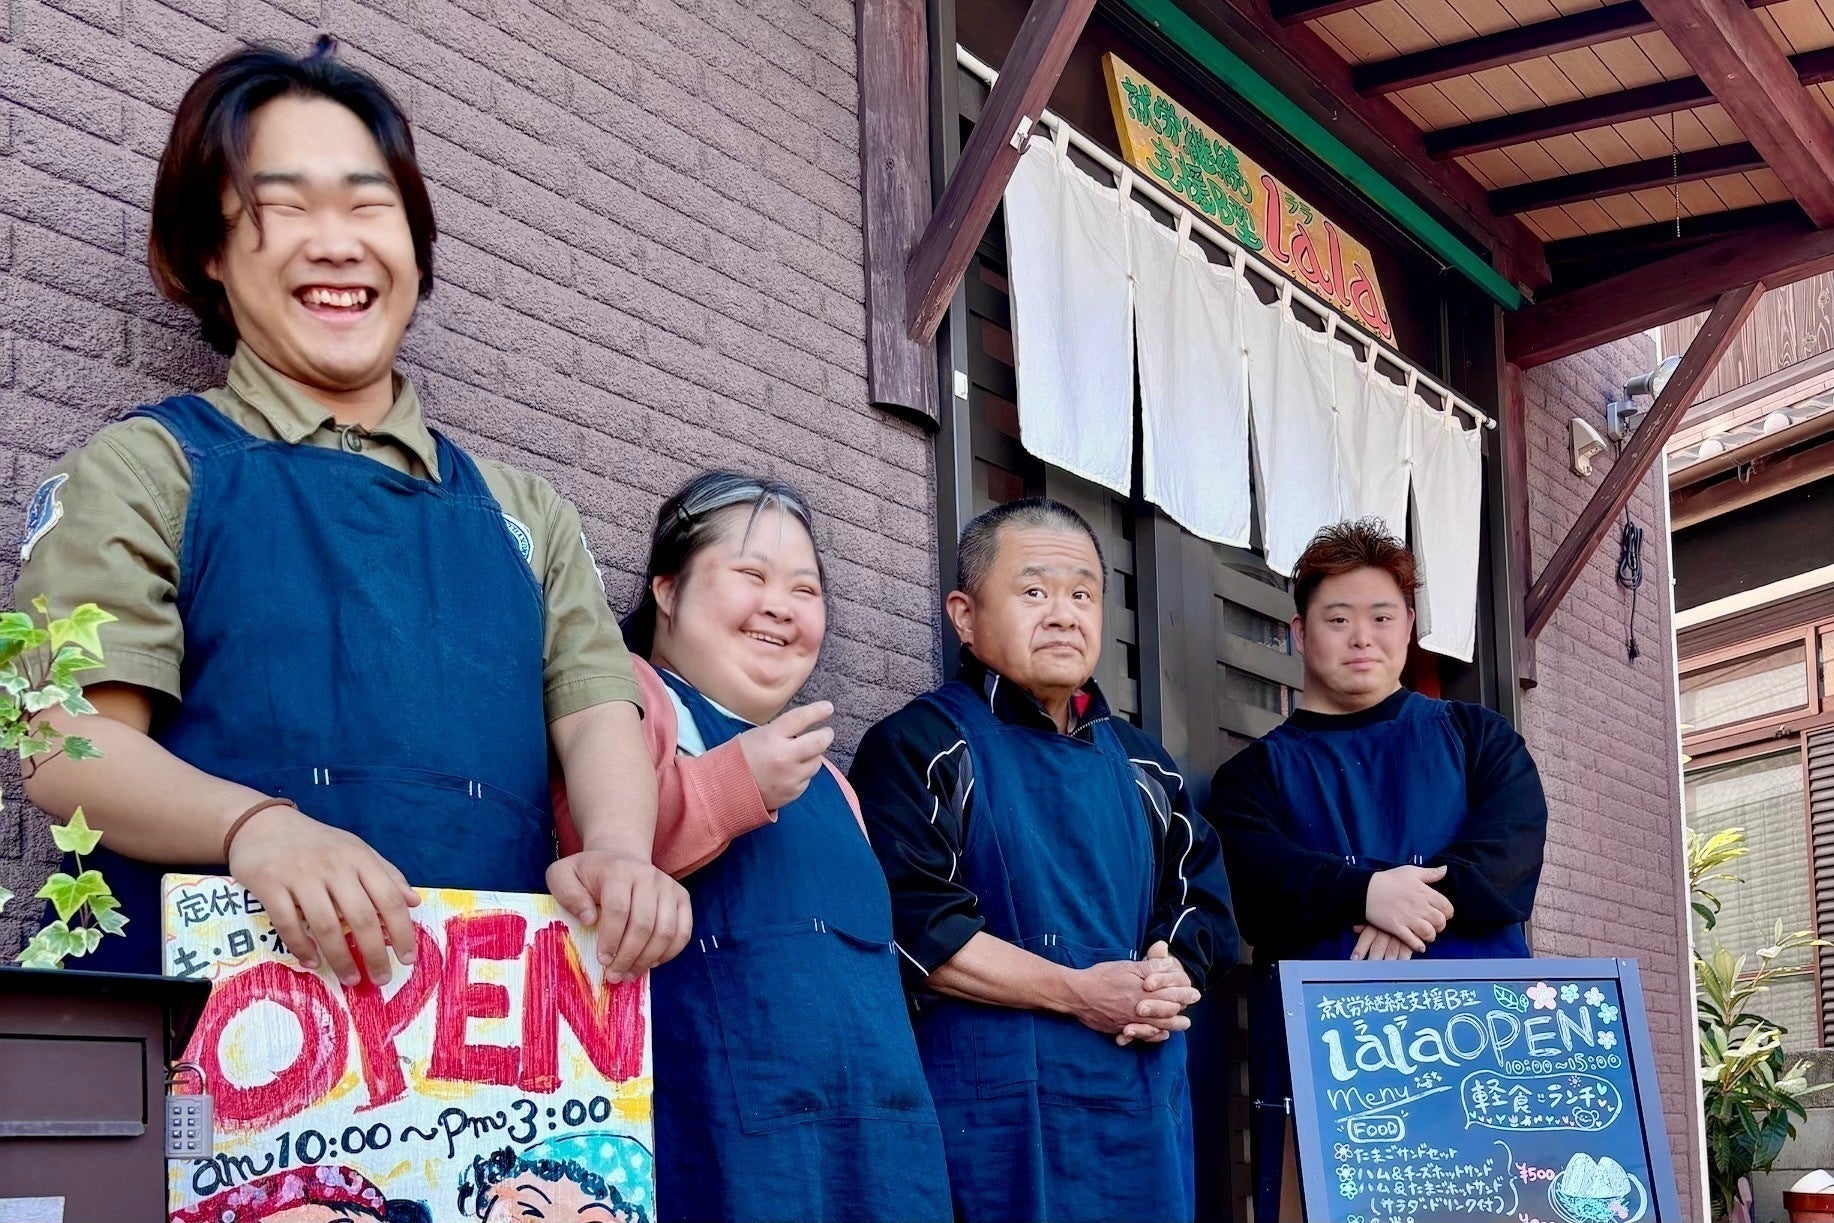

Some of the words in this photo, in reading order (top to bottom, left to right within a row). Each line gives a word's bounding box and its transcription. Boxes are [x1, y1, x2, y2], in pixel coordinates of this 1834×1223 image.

[1121, 76, 1253, 204] 就労継続
[1146, 136, 1264, 251] 支援B型
[1284, 191, 1314, 225] ララ
[1261, 174, 1392, 339] lala
[172, 909, 648, 1132] OPEN
[1317, 986, 1482, 1022] 就労継続支援B型
[1321, 1023, 1461, 1082] lala
[1444, 1005, 1595, 1068] OPEN
[1353, 1121, 1398, 1138] FOOD
[1353, 1142, 1458, 1164] たまごサンドセット
[1515, 1162, 1556, 1185] ¥500
